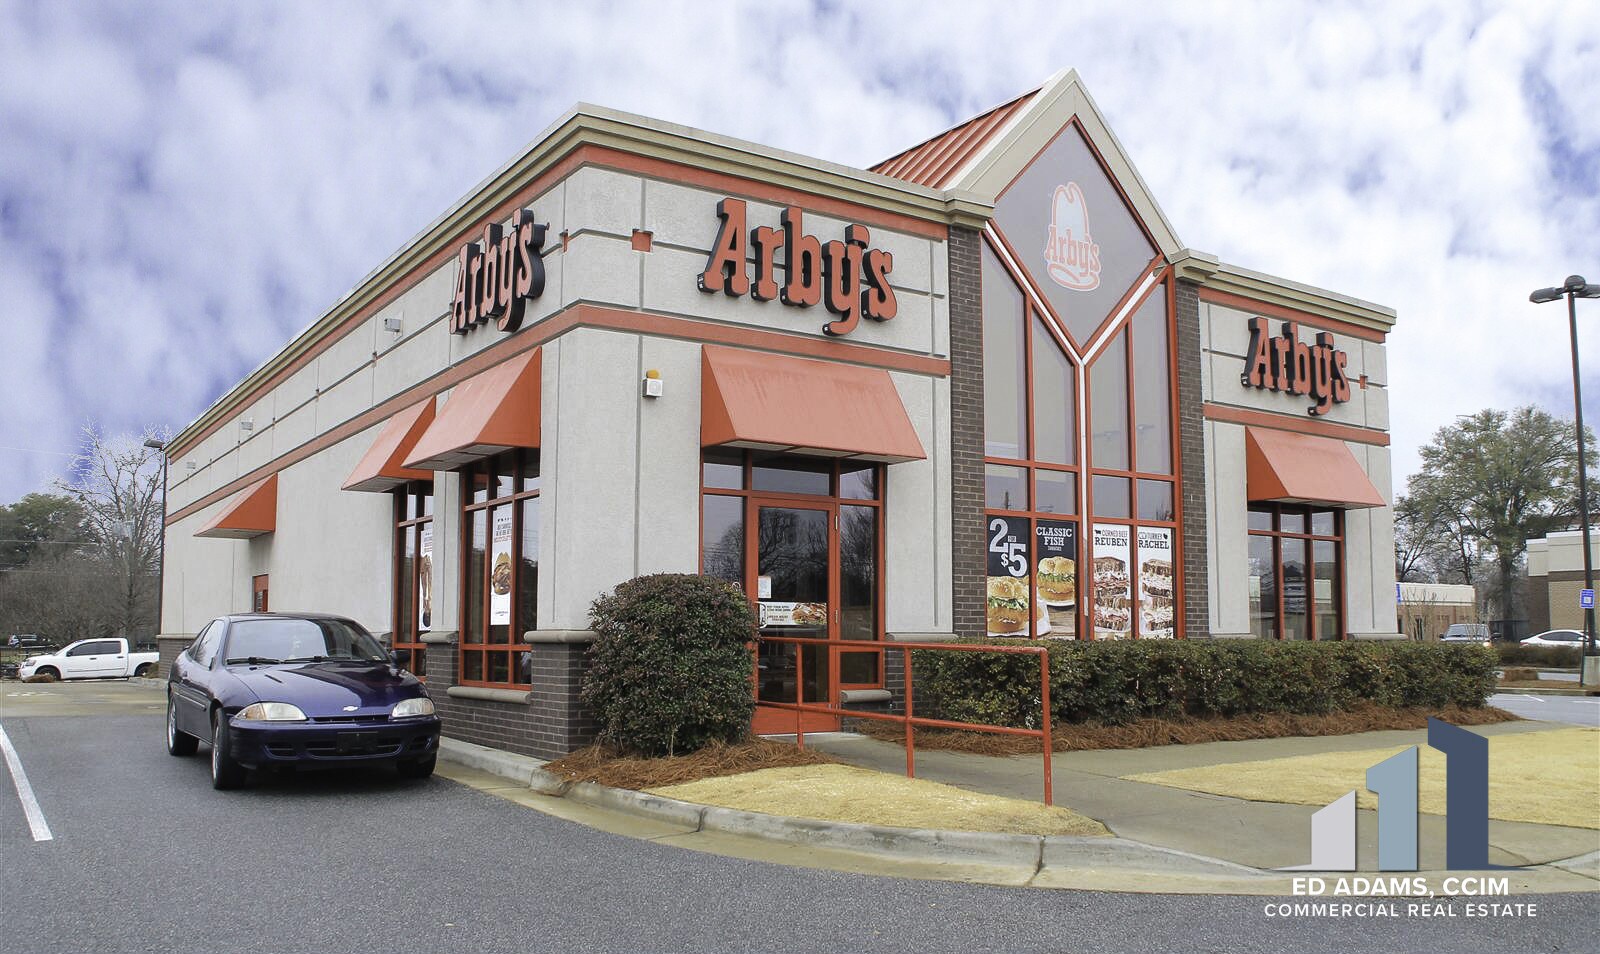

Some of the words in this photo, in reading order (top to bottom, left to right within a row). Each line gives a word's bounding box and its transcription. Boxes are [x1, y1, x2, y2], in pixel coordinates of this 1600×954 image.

[449, 208, 546, 335] Arby's
[697, 197, 898, 337] Arby's
[1240, 316, 1351, 416] Arby's
[989, 518, 1009, 553] 2
[1035, 526, 1073, 538] CLASSIC
[1044, 536, 1065, 547] FISH
[1094, 536, 1128, 547] REUBEN
[1138, 539, 1170, 550] RACHEL
